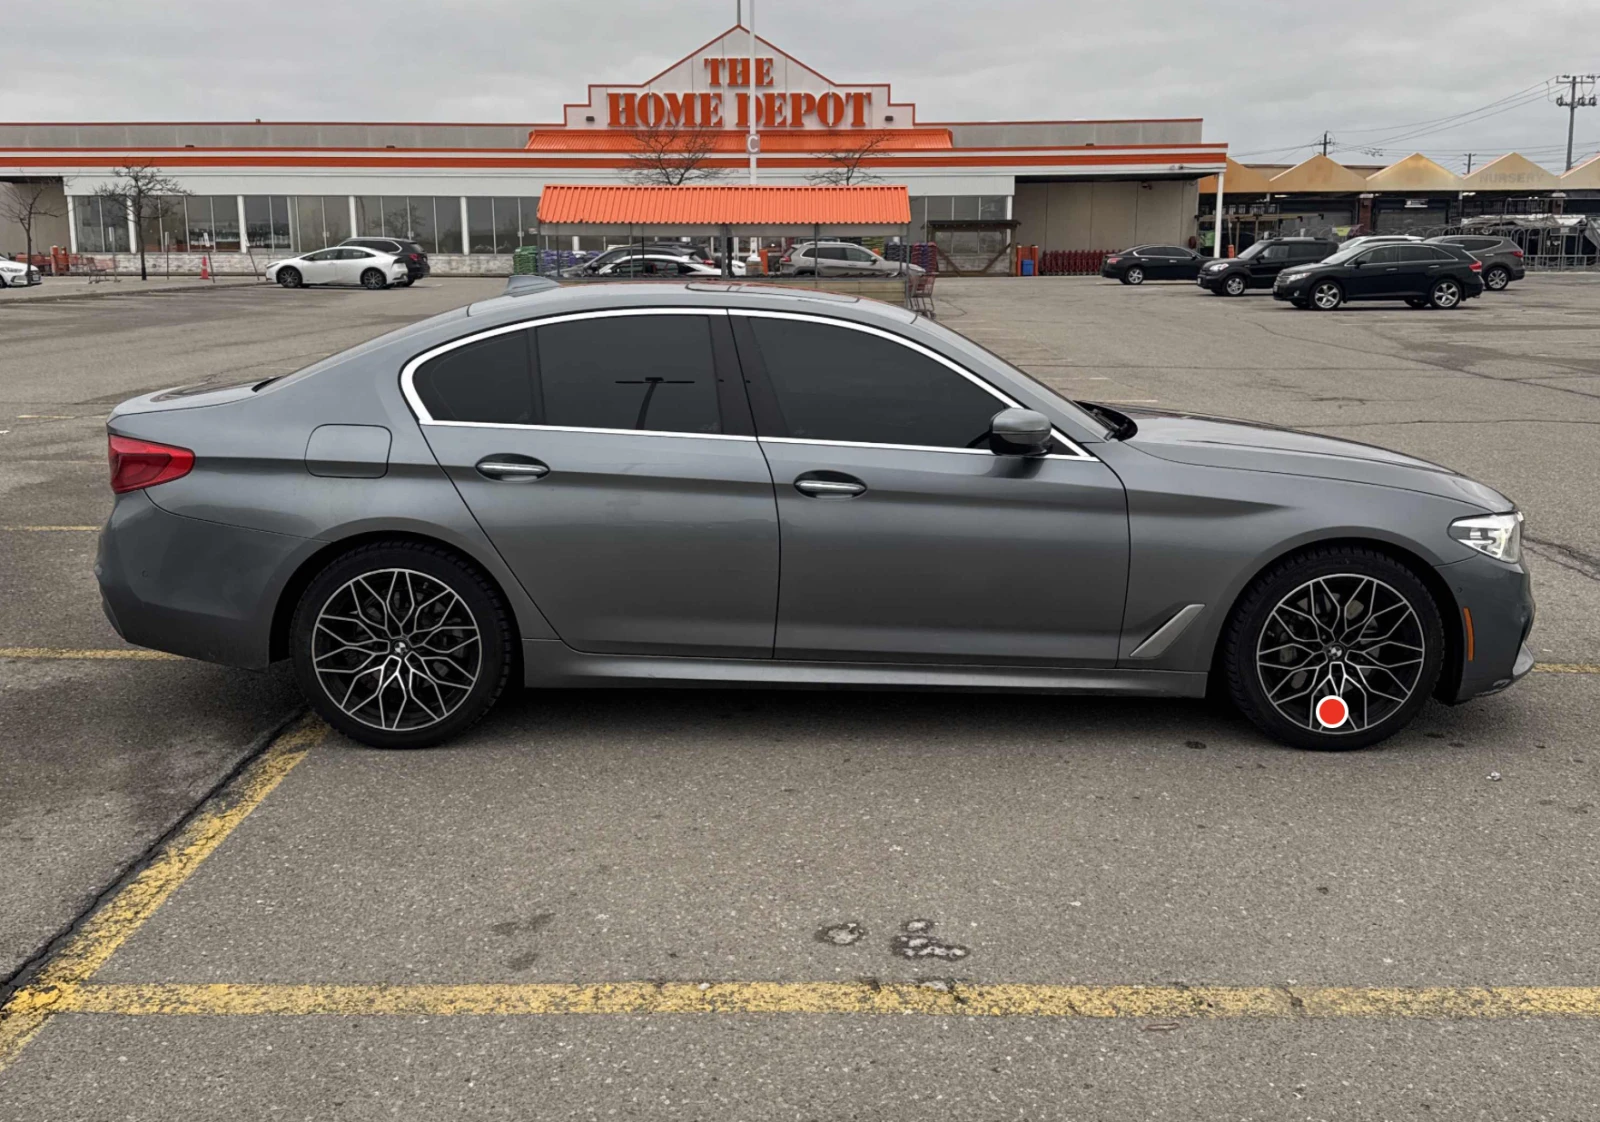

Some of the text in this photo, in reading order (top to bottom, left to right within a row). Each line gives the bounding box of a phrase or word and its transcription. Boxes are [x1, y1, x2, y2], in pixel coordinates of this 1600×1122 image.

[704, 57, 773, 87] THE
[607, 92, 872, 127] HOME DEPOT
[747, 135, 759, 153] C
[1480, 172, 1544, 184] NURSERY
